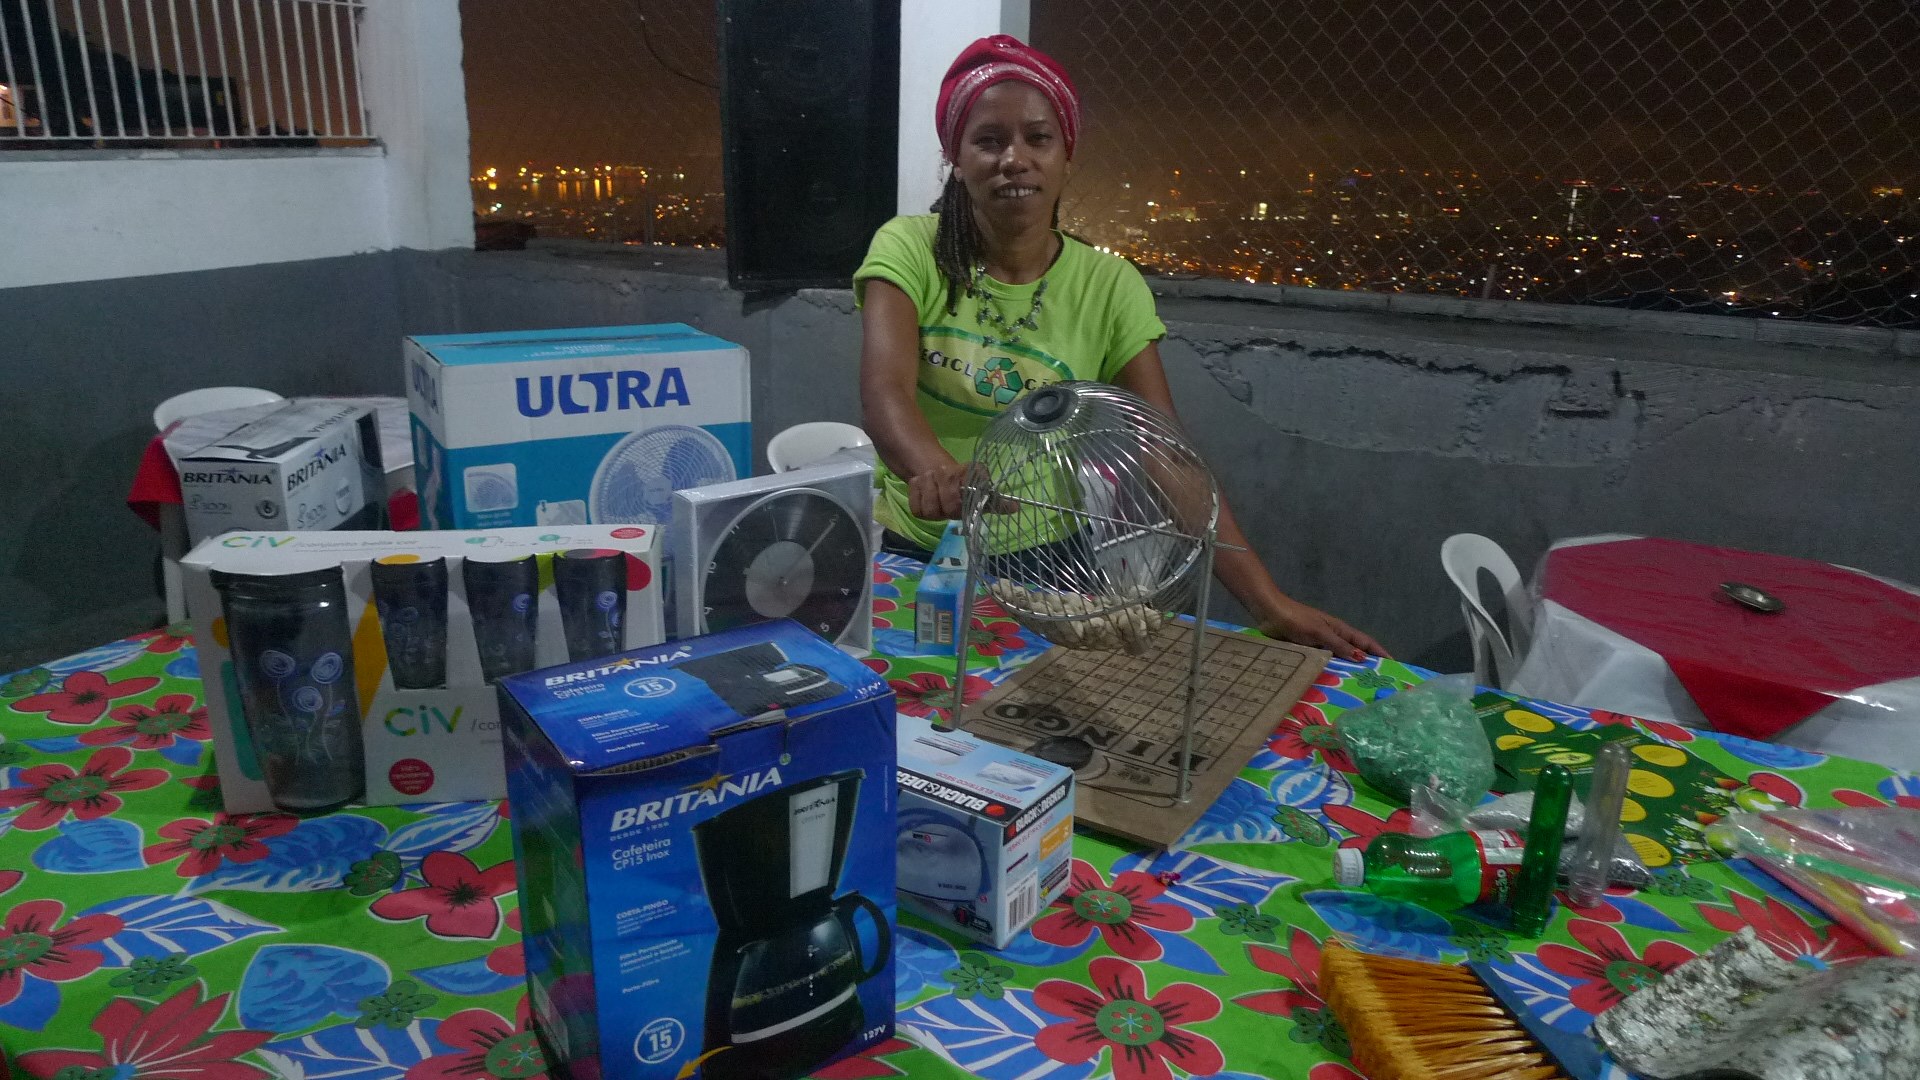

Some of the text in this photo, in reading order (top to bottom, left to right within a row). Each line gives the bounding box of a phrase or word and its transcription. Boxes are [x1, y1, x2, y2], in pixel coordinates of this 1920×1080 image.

[515, 367, 691, 418] ULTRA
[183, 470, 273, 485] BRITANIA
[609, 765, 783, 833] BRITANIA
[611, 838, 672, 861] Cafeteira
[612, 848, 671, 871] CP15 Inox
[649, 1029, 673, 1052] 15
